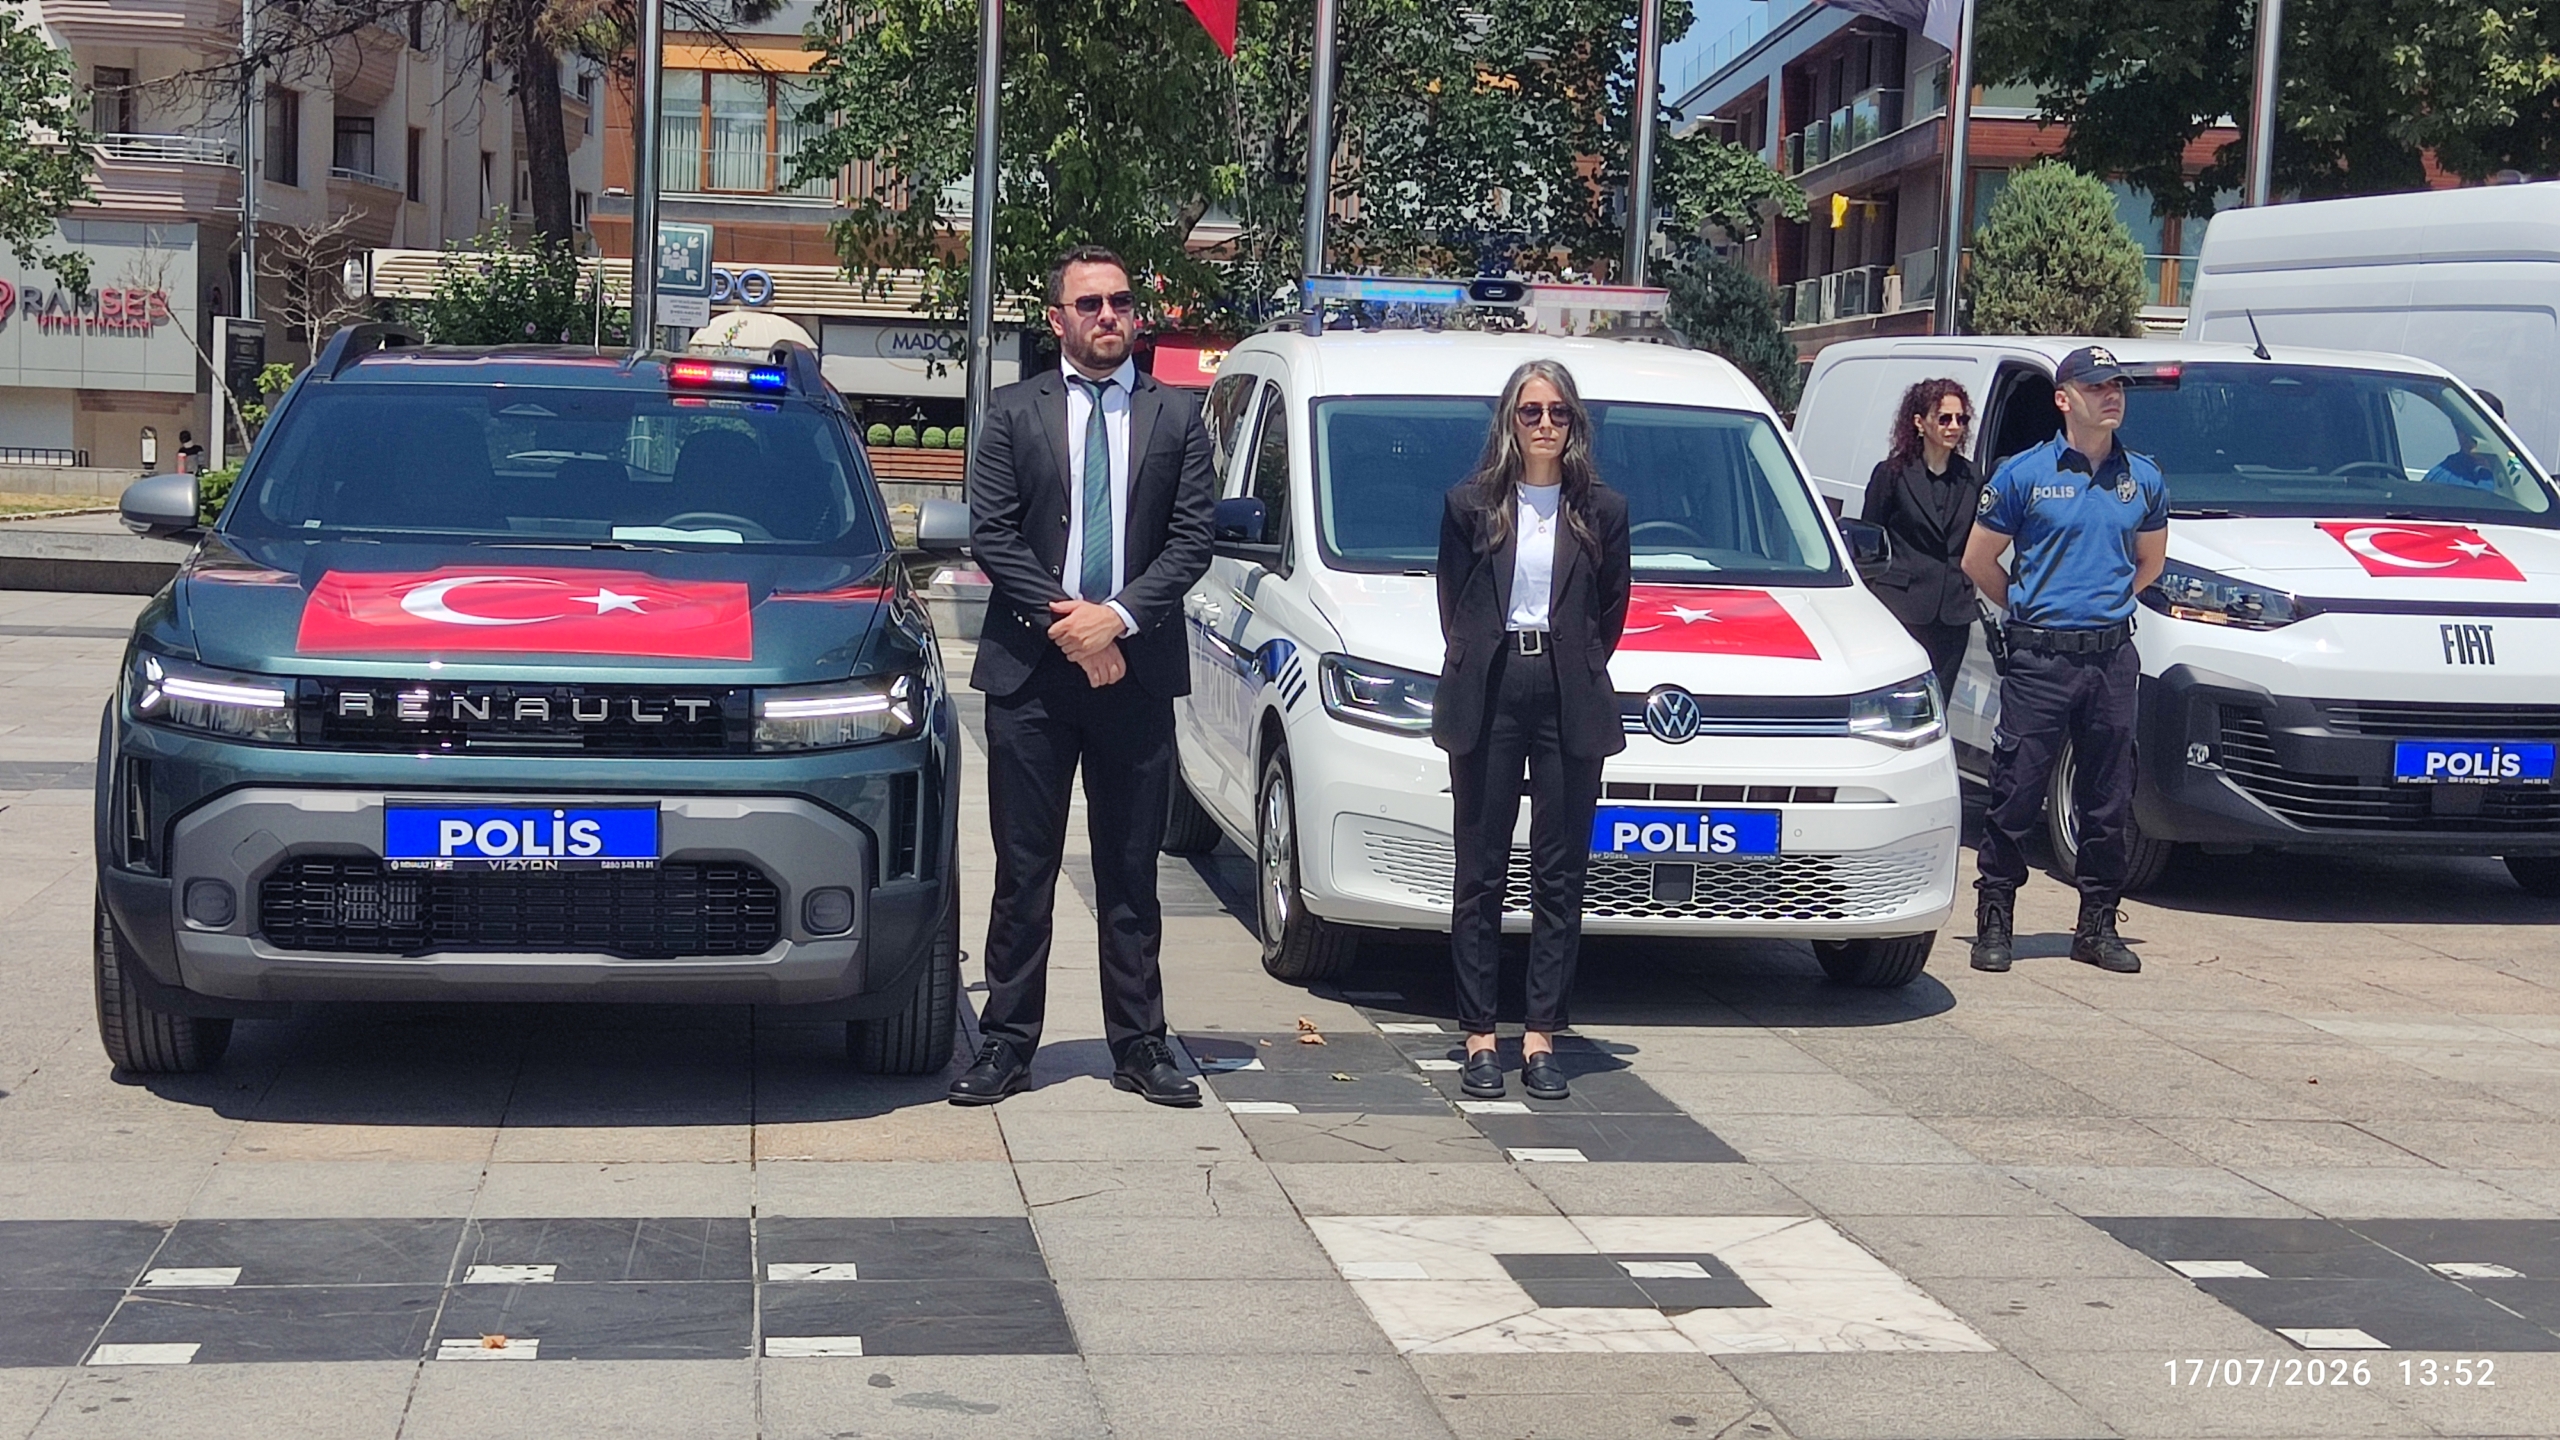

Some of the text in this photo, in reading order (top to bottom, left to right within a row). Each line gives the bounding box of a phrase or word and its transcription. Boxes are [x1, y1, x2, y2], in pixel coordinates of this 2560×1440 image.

[20, 286, 169, 317] RAMSES
[892, 332, 954, 351] MADO
[2440, 624, 2496, 665] FIAT
[338, 690, 711, 723] RENAULT
[2425, 746, 2521, 777] POLİS
[439, 808, 602, 857] POLİS
[1613, 814, 1737, 853] POLİS
[487, 860, 559, 871] VIZYON
